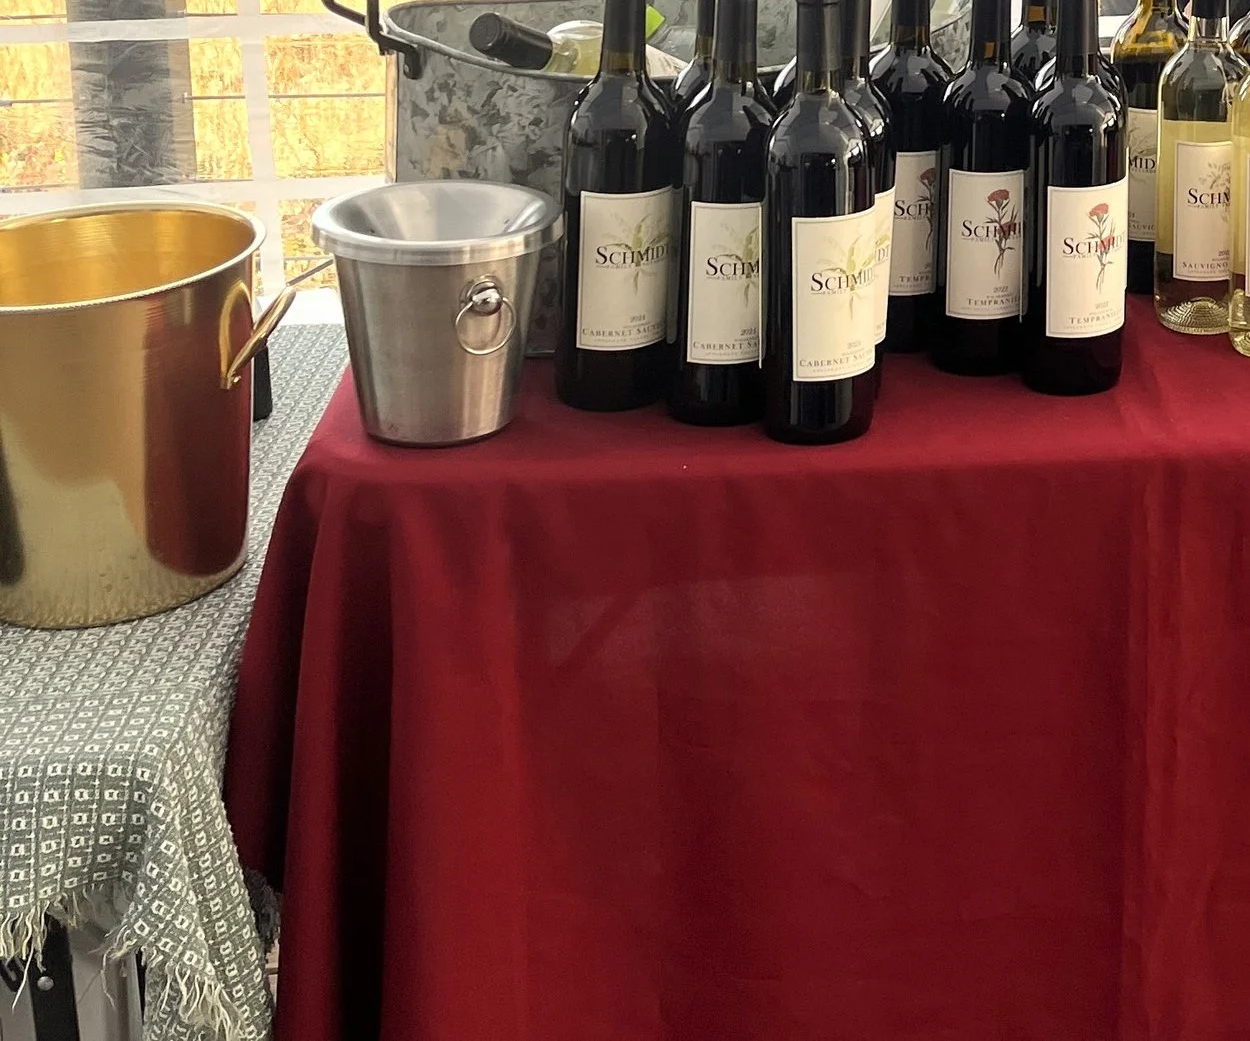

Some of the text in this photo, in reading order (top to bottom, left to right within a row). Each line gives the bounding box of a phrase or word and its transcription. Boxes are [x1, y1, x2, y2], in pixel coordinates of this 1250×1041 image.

[1182, 261, 1229, 269] SAUVIGNO
[582, 327, 632, 337] CABERNET
[693, 341, 743, 350] CABERNET
[799, 357, 850, 367] CABERNET
